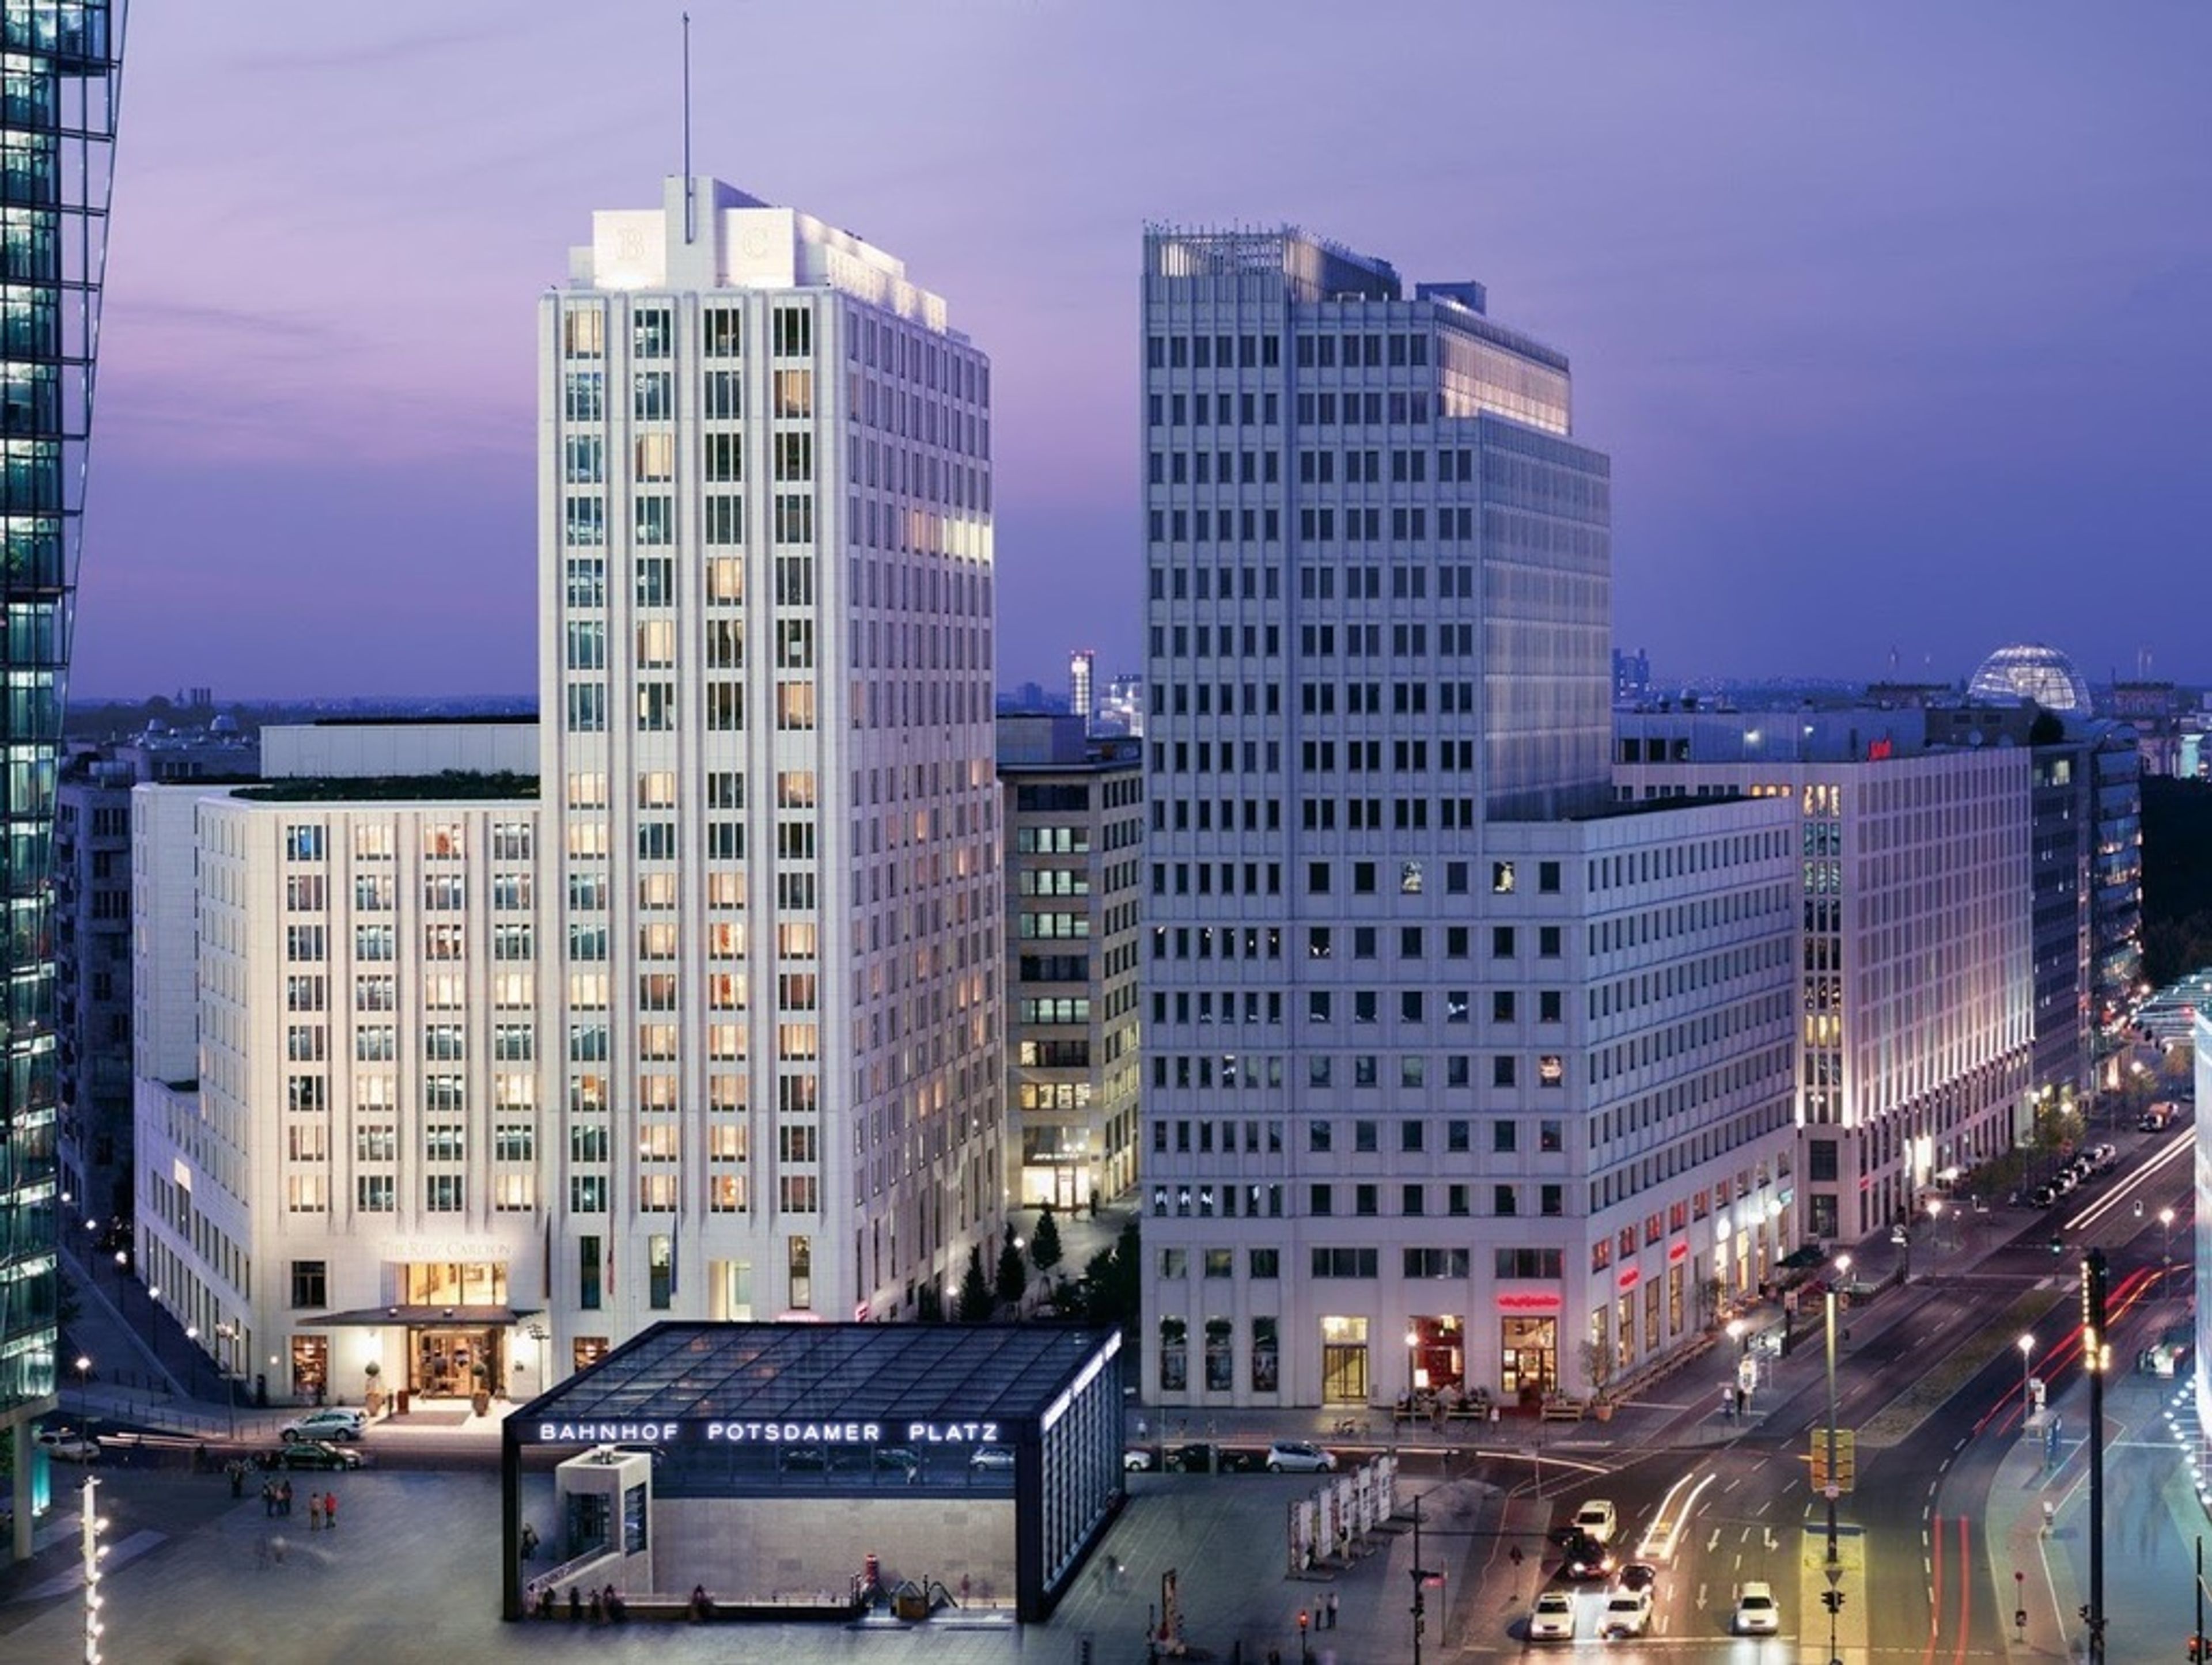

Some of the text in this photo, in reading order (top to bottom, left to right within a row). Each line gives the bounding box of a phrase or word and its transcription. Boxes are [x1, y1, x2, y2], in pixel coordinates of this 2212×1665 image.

[446, 1241, 512, 1256] CARLTON
[540, 1423, 997, 1441] BAHNHOF POTSDAMER PLATZ
